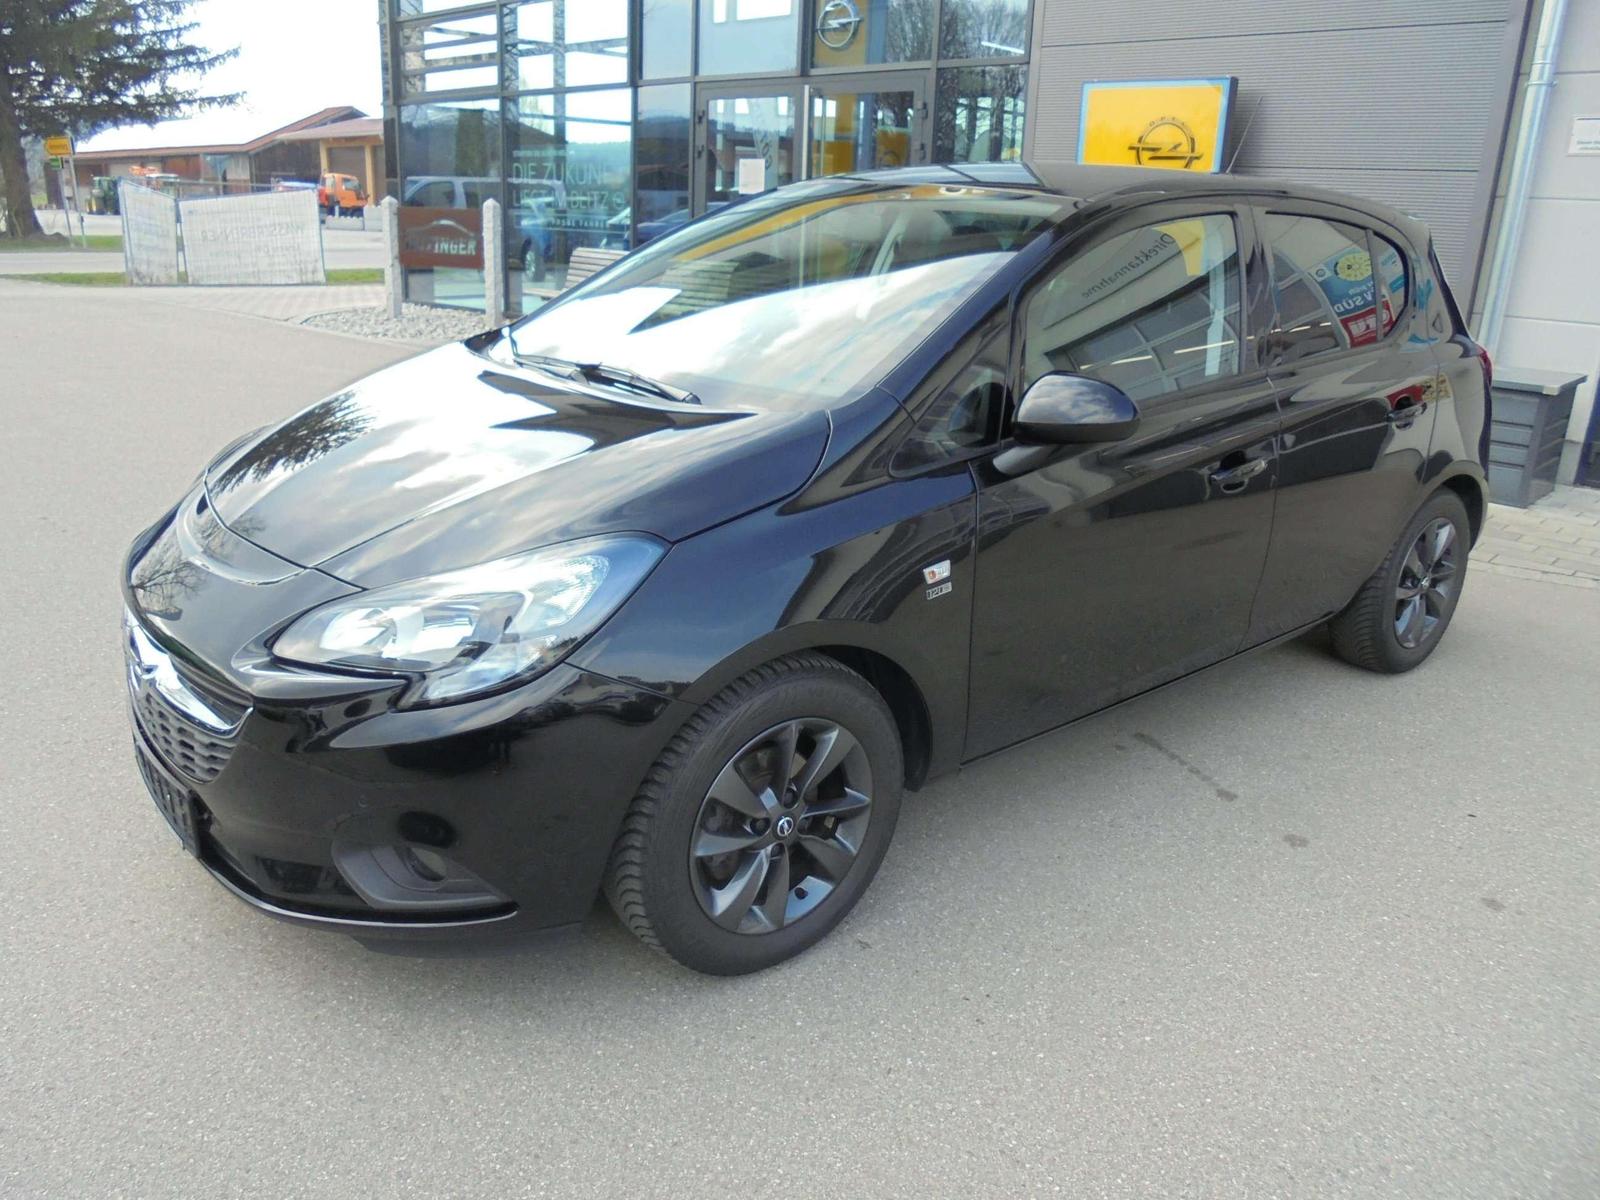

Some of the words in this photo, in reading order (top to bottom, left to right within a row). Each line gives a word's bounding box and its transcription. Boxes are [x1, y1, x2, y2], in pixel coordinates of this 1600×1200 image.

[513, 162, 537, 184] DIE
[542, 162, 618, 185] ZUKUN
[570, 191, 609, 209] BLITZ
